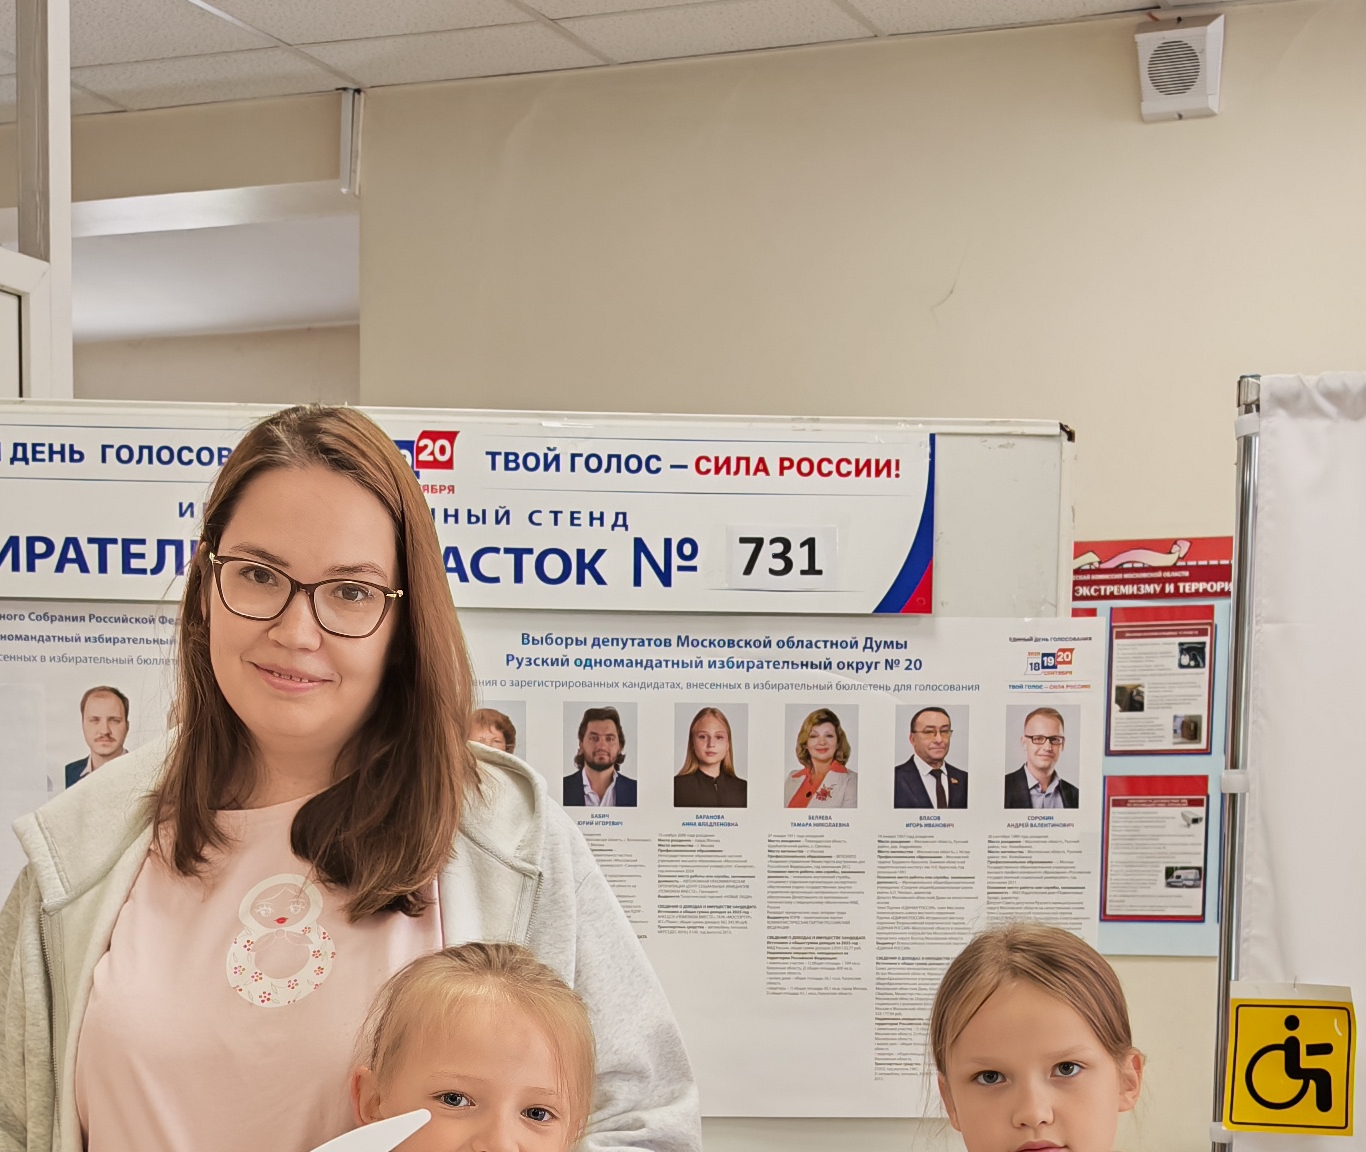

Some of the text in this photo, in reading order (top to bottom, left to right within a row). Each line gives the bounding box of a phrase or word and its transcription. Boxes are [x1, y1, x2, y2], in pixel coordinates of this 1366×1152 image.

[10, 442, 85, 465] ДЕНЬ
[418, 438, 451, 462] 20
[485, 447, 901, 478] ТВОЙ ГОЛОС СИЛА РОССИИ!
[528, 510, 629, 531] СТЕНД
[633, 536, 699, 588] №
[739, 536, 823, 576] 731
[1075, 583, 1163, 597] ЭКСТРЕМИЗМУ
[1165, 583, 1174, 593] И
[28, 612, 85, 624] Собрания
[89, 614, 155, 625] Российской
[522, 633, 907, 653] Выборы депутатов Московской областной Думы
[49, 654, 133, 666] избирательный
[506, 654, 922, 673] Рузский одномандатный избирательный округ № 20
[1043, 656, 1054, 666] 19
[1057, 652, 1071, 661] 20
[1029, 662, 1040, 671] 18
[500, 679, 506, 687] о
[510, 679, 619, 690] зарегистрированных
[622, 681, 683, 690] кандидатах,
[686, 681, 742, 690] внесенных
[753, 681, 832, 692] избирательный
[836, 681, 890, 692] бюллетень
[893, 684, 911, 692] для
[915, 683, 979, 692] голосования
